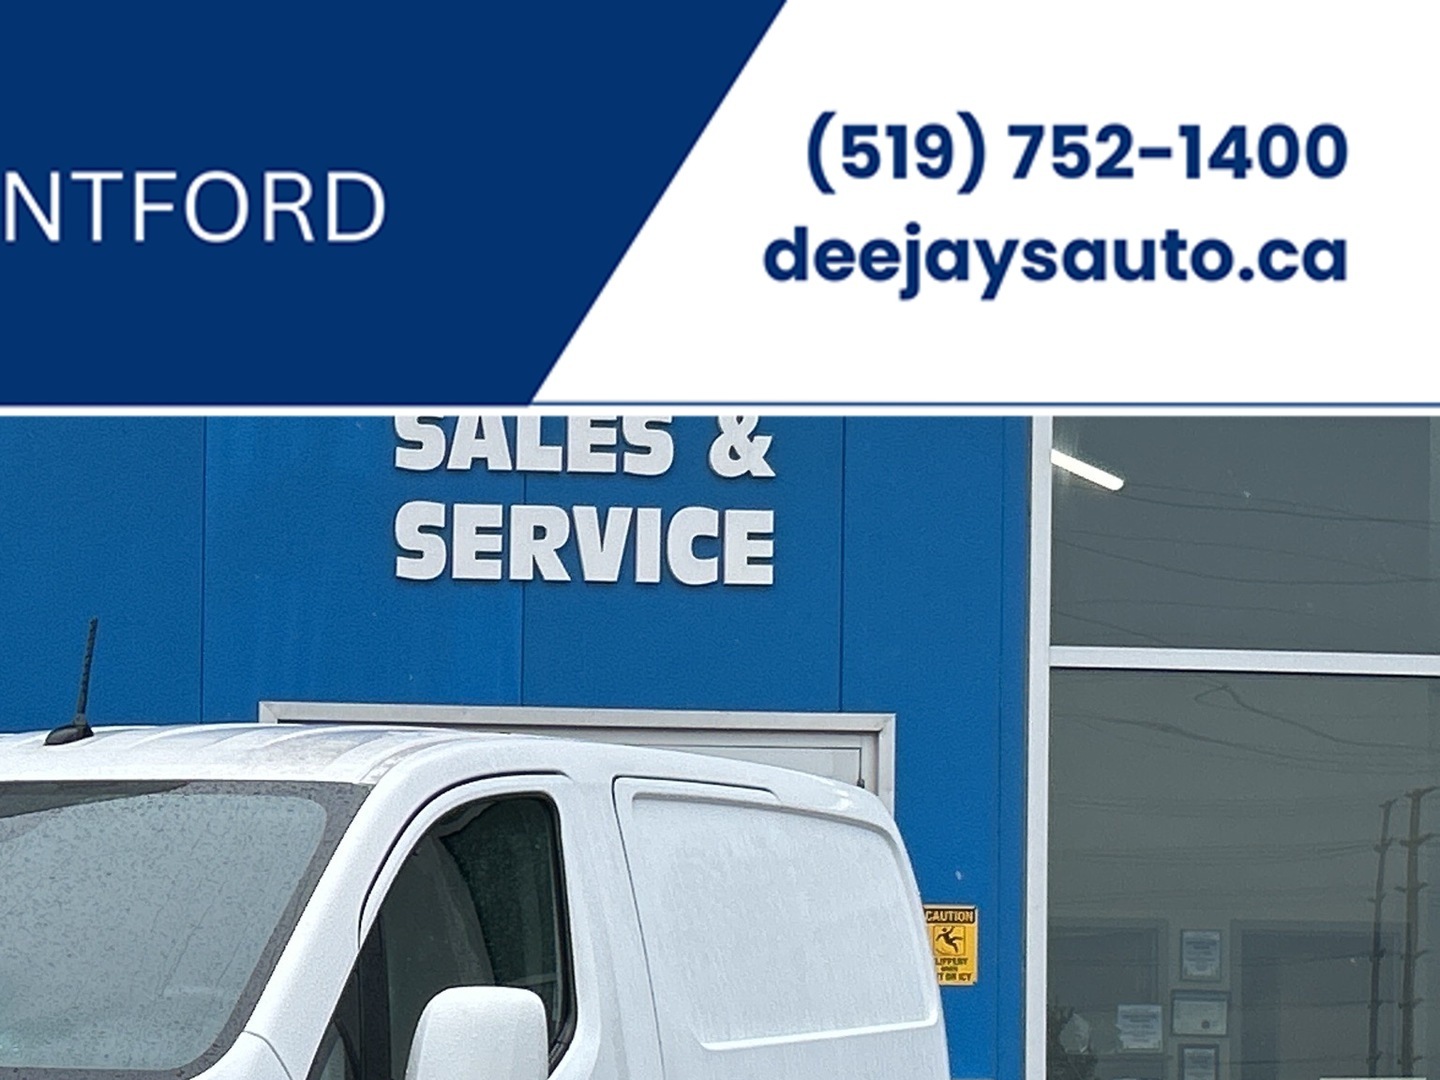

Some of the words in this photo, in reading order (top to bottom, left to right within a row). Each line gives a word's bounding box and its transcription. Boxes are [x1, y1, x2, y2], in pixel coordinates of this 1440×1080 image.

[394, 415, 674, 475] SALES
[709, 415, 776, 477] &
[394, 500, 774, 585] SERVICE
[925, 910, 974, 922] CAUTION
[934, 957, 968, 965] LIPPERY
